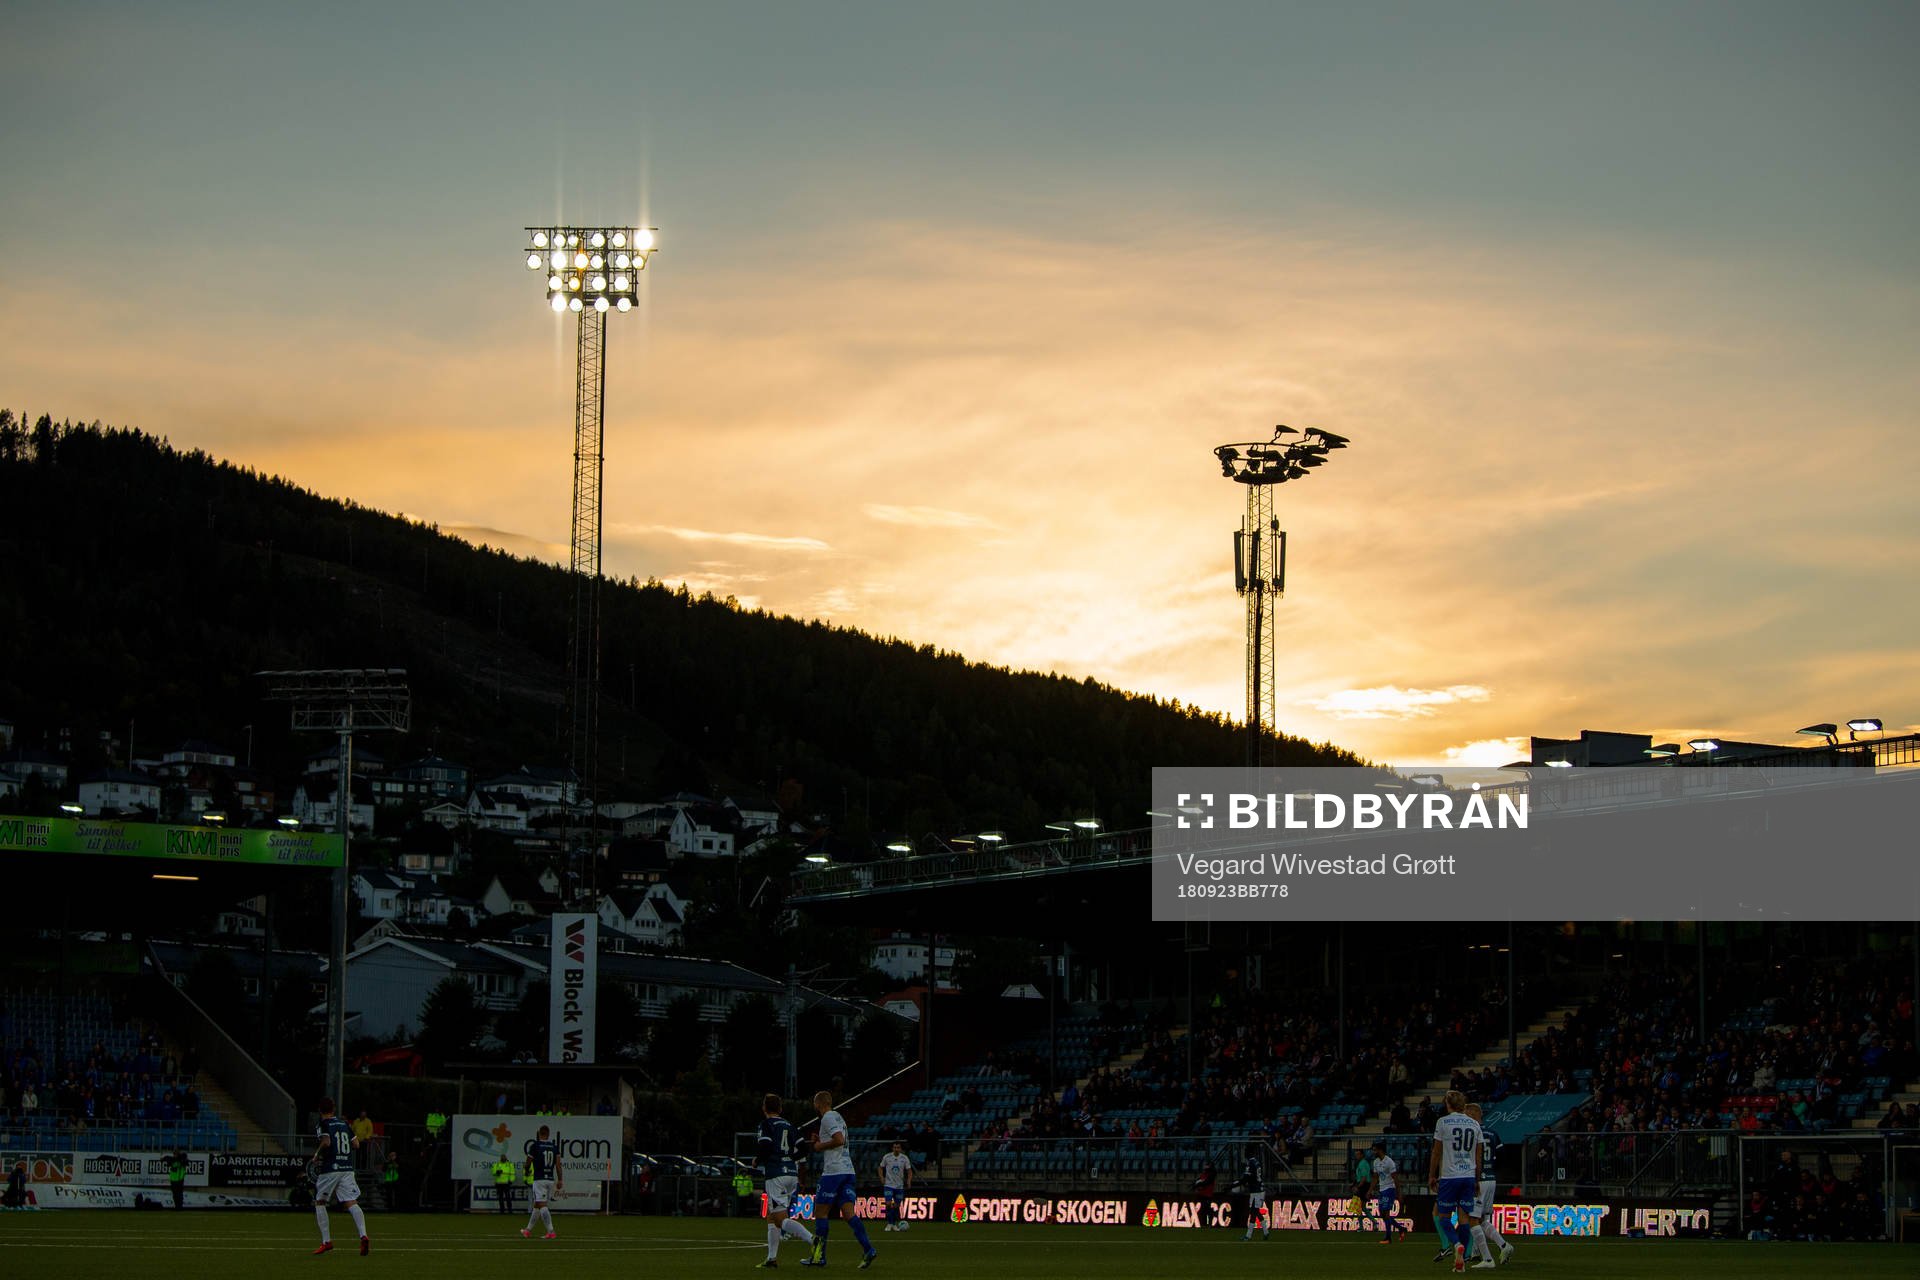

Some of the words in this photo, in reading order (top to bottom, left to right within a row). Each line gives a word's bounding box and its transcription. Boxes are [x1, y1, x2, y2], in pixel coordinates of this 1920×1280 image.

[0, 819, 24, 846] WI
[27, 822, 50, 834] mini
[220, 833, 242, 845] mini
[27, 836, 48, 848] pris
[166, 829, 217, 856] KIWI
[219, 845, 240, 858] pris
[564, 968, 584, 1023] Block
[563, 1029, 583, 1063] Wa
[335, 1131, 351, 1154] 18
[780, 1129, 790, 1154] 4
[1452, 1127, 1475, 1151] 30
[84, 1159, 141, 1176] HØGEVARDE
[149, 1160, 205, 1175] HØGRDE
[227, 1156, 288, 1166] ARKITEKTER
[289, 1157, 303, 1166] AS
[542, 1150, 554, 1168] 10
[54, 1185, 123, 1199] Prysmian
[970, 1198, 1020, 1222] SPORT
[1161, 1202, 1201, 1228] MAX
[1271, 1200, 1321, 1230] MAX
[1493, 1204, 1604, 1236] TERSPORT
